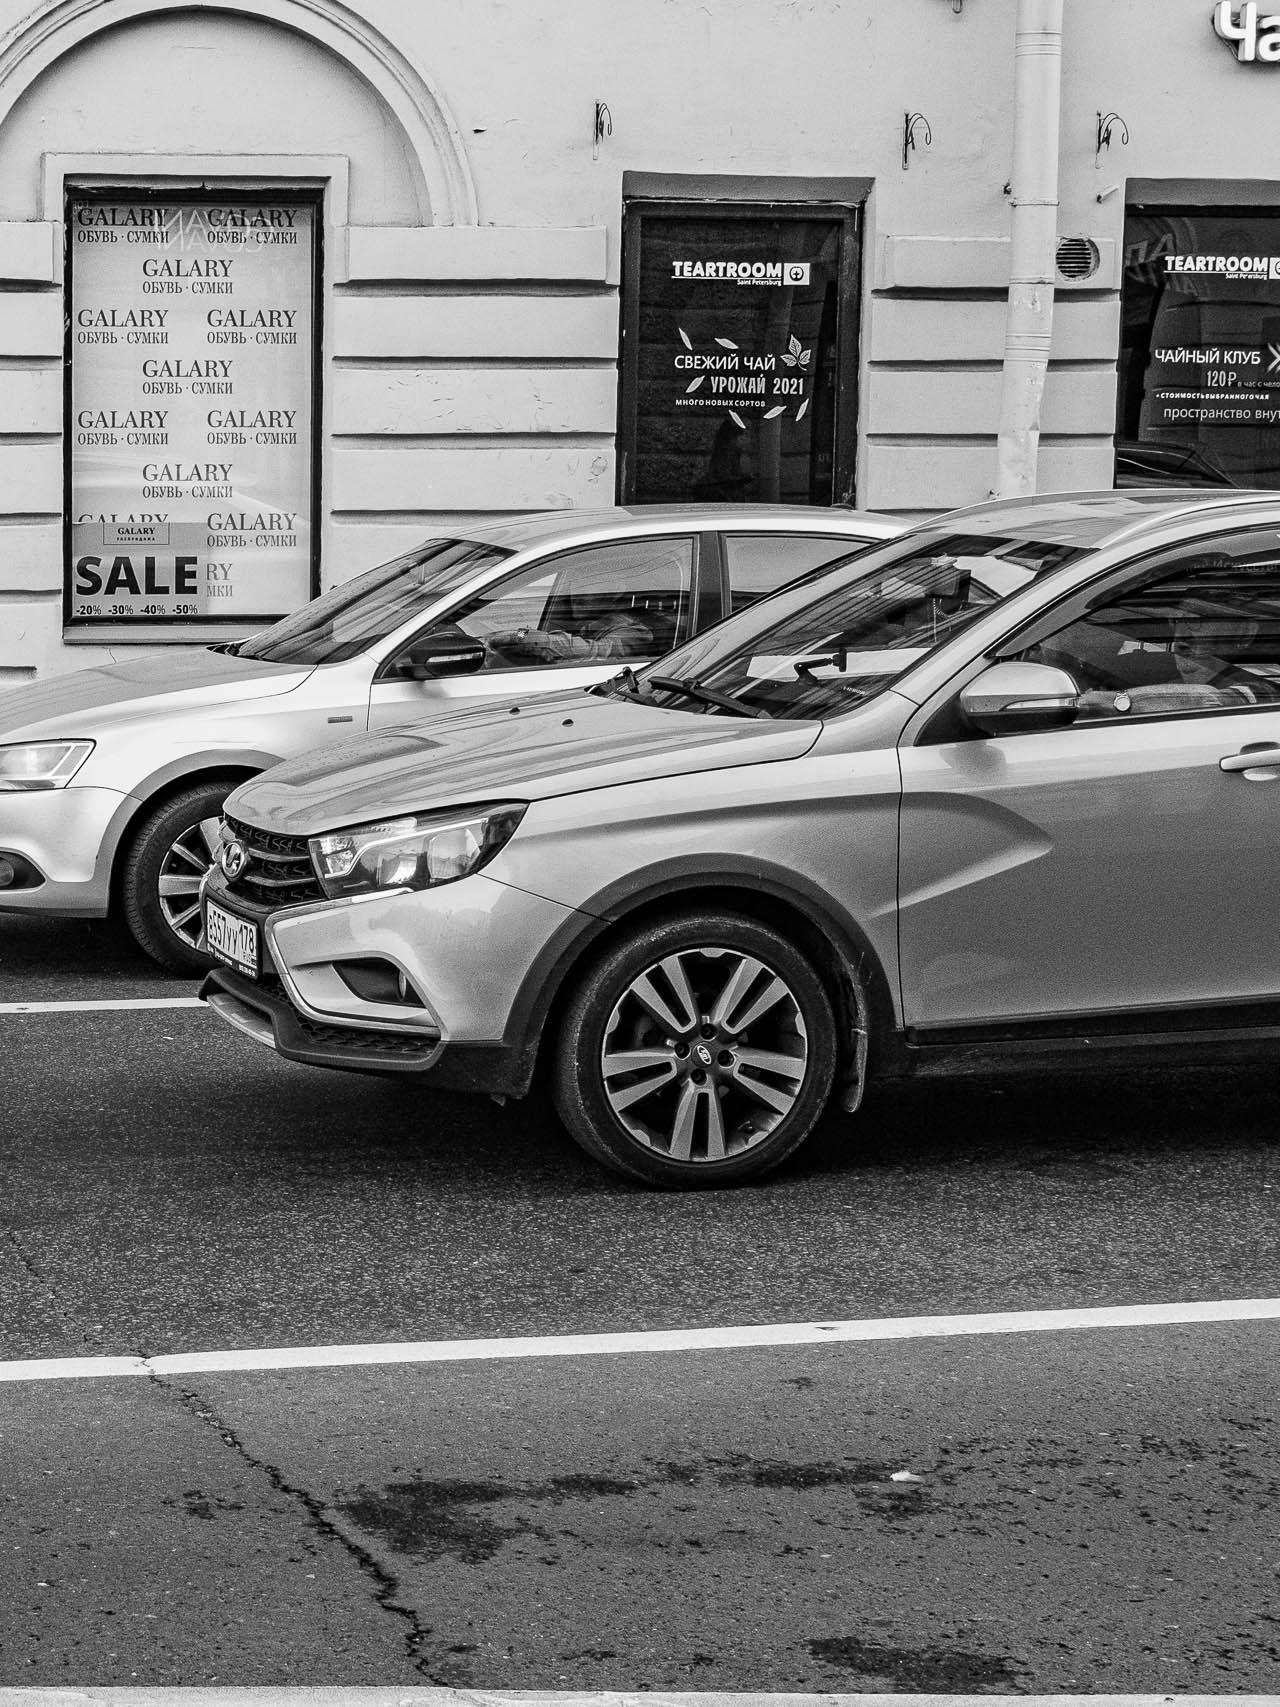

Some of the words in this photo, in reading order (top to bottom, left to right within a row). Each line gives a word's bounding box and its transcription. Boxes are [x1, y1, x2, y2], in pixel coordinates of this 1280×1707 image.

[77, 208, 169, 227] GALARY
[78, 231, 117, 243] ОБУВЬ
[127, 231, 169, 243] СУМКИ
[256, 232, 297, 244] СУМКИ
[143, 259, 233, 277] GALARY
[672, 261, 782, 278] TEARTROOM
[1164, 256, 1269, 272] TEARTROOM
[143, 281, 182, 293] ОБУВЬ
[192, 282, 232, 294] СУМКИ
[78, 309, 168, 327] GALARY
[207, 309, 297, 327] GALARY
[78, 332, 117, 344] ОБУВЬ
[127, 332, 168, 344] СУМКИ
[207, 332, 246, 344] ОБУВЬ
[256, 332, 296, 344] СУМКИ
[674, 353, 739, 370] СВЕЖИЙ
[743, 354, 776, 370] ЧАЙ
[1155, 347, 1220, 364] ЧАЙНЫЙ
[1223, 350, 1261, 365] КЛУБ
[143, 360, 232, 377] GALARY
[143, 382, 182, 394] ОБУВЬ
[192, 382, 232, 394] СУМКИ
[710, 374, 766, 394] УРОЖАЙ
[772, 377, 804, 395] 2021
[78, 411, 168, 428] GALARY
[208, 410, 296, 428] GALARY
[1164, 408, 1251, 421] пространство
[78, 433, 117, 445] ОБУВЬ
[127, 433, 168, 445] СУМКИ
[207, 432, 246, 444] ОБУВЬ
[256, 432, 296, 444] СУМКИ
[143, 464, 232, 481] GALARY
[143, 486, 182, 498] ОБУВЬ
[192, 486, 232, 498] СУМКИ
[206, 513, 297, 531] GALARY
[117, 527, 156, 535] GALARY
[207, 535, 246, 548] ОБУВЬ
[256, 535, 296, 547] СУМКИ
[76, 556, 198, 596] SALE
[76, 605, 102, 615] -20%
[108, 605, 134, 615] -30%
[140, 605, 166, 615] -40%
[172, 604, 198, 615] -50%
